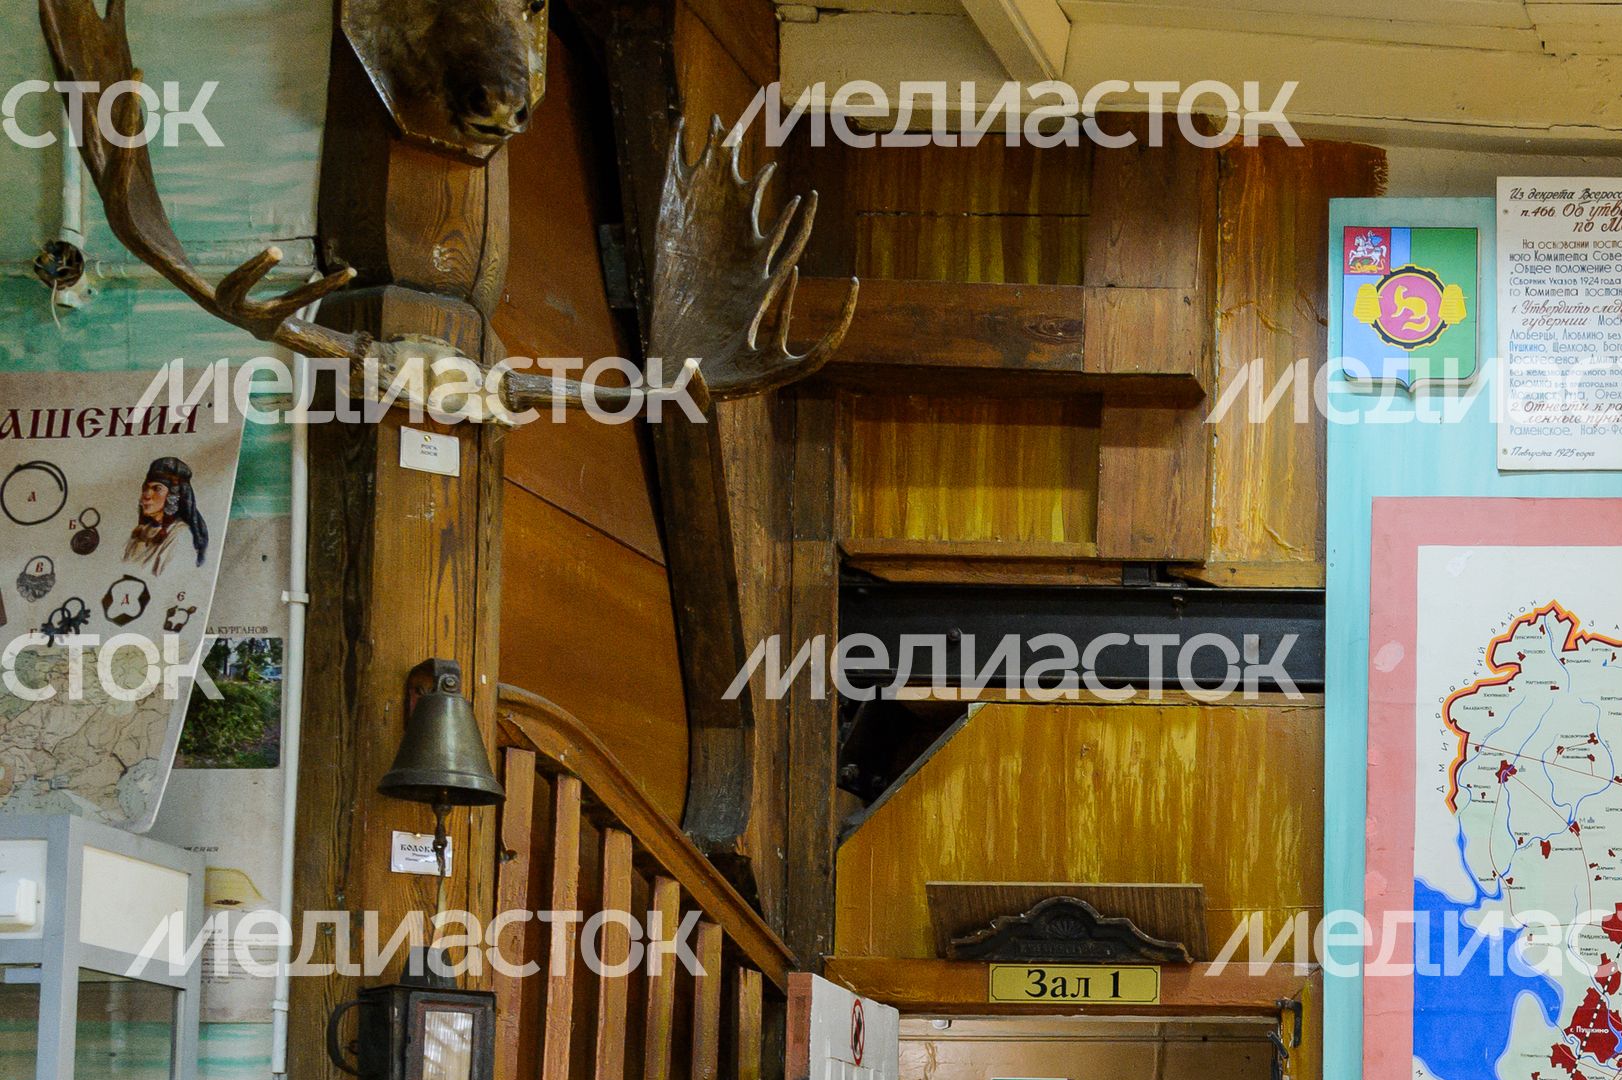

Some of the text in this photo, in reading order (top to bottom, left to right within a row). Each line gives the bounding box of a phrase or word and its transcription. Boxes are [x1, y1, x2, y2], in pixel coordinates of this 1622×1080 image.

[1510, 188, 1523, 199] Из
[1528, 188, 1574, 201] декрета
[1563, 201, 1594, 217] Об
[1573, 220, 1594, 232] по
[1523, 239, 1535, 249] На
[1538, 240, 1589, 249] основании
[1535, 251, 1587, 262] Комитета
[1556, 263, 1611, 273] положение
[1581, 277, 1599, 285] 1924
[1525, 286, 1578, 296] Комитета
[1522, 300, 1590, 314] Утвердить
[1562, 329, 1604, 340] Люблино
[1024, 969, 1122, 998] Зал 1
